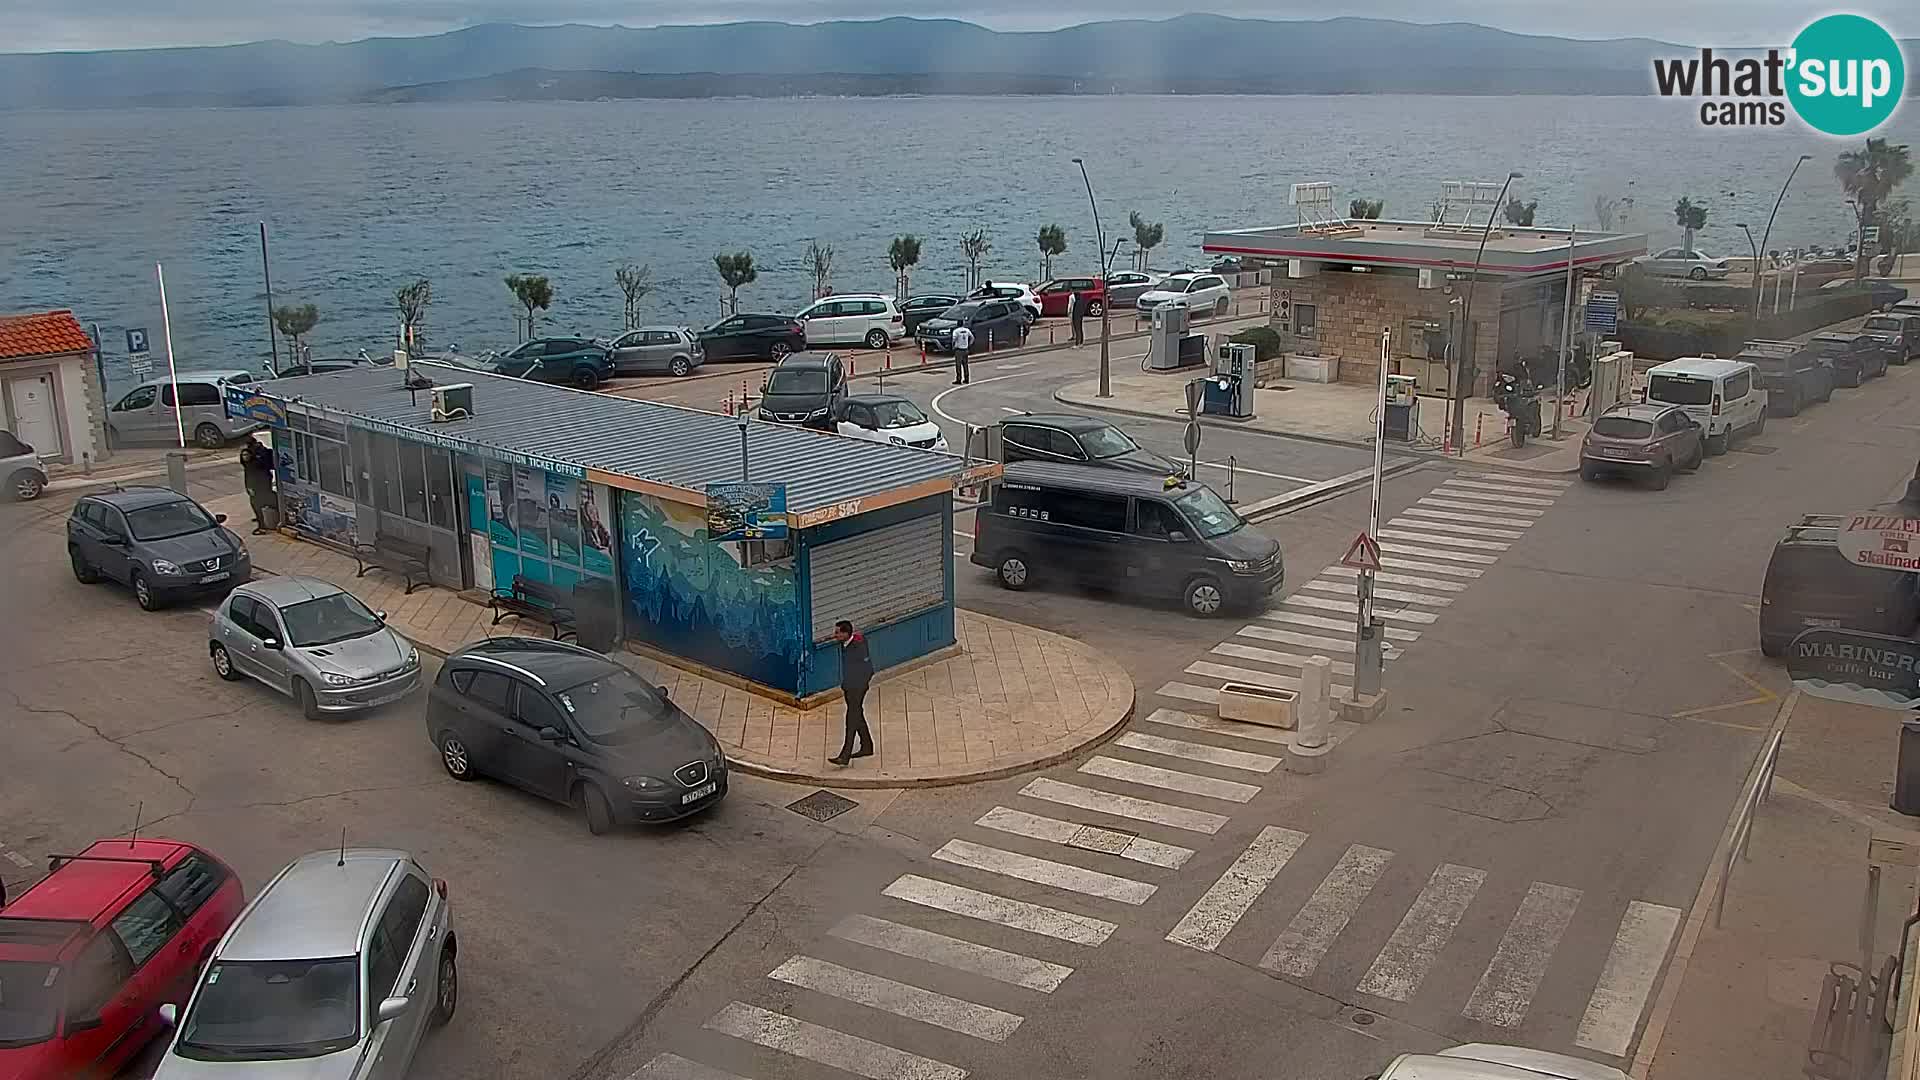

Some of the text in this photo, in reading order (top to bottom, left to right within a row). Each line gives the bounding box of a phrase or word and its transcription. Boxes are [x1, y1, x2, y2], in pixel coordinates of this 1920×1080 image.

[131, 331, 143, 350] P
[437, 438, 467, 451] POSTAJA
[495, 448, 526, 464] STATION
[529, 456, 554, 471] TICKET
[556, 462, 582, 476] OFFICE
[1869, 666, 1895, 680] bar
